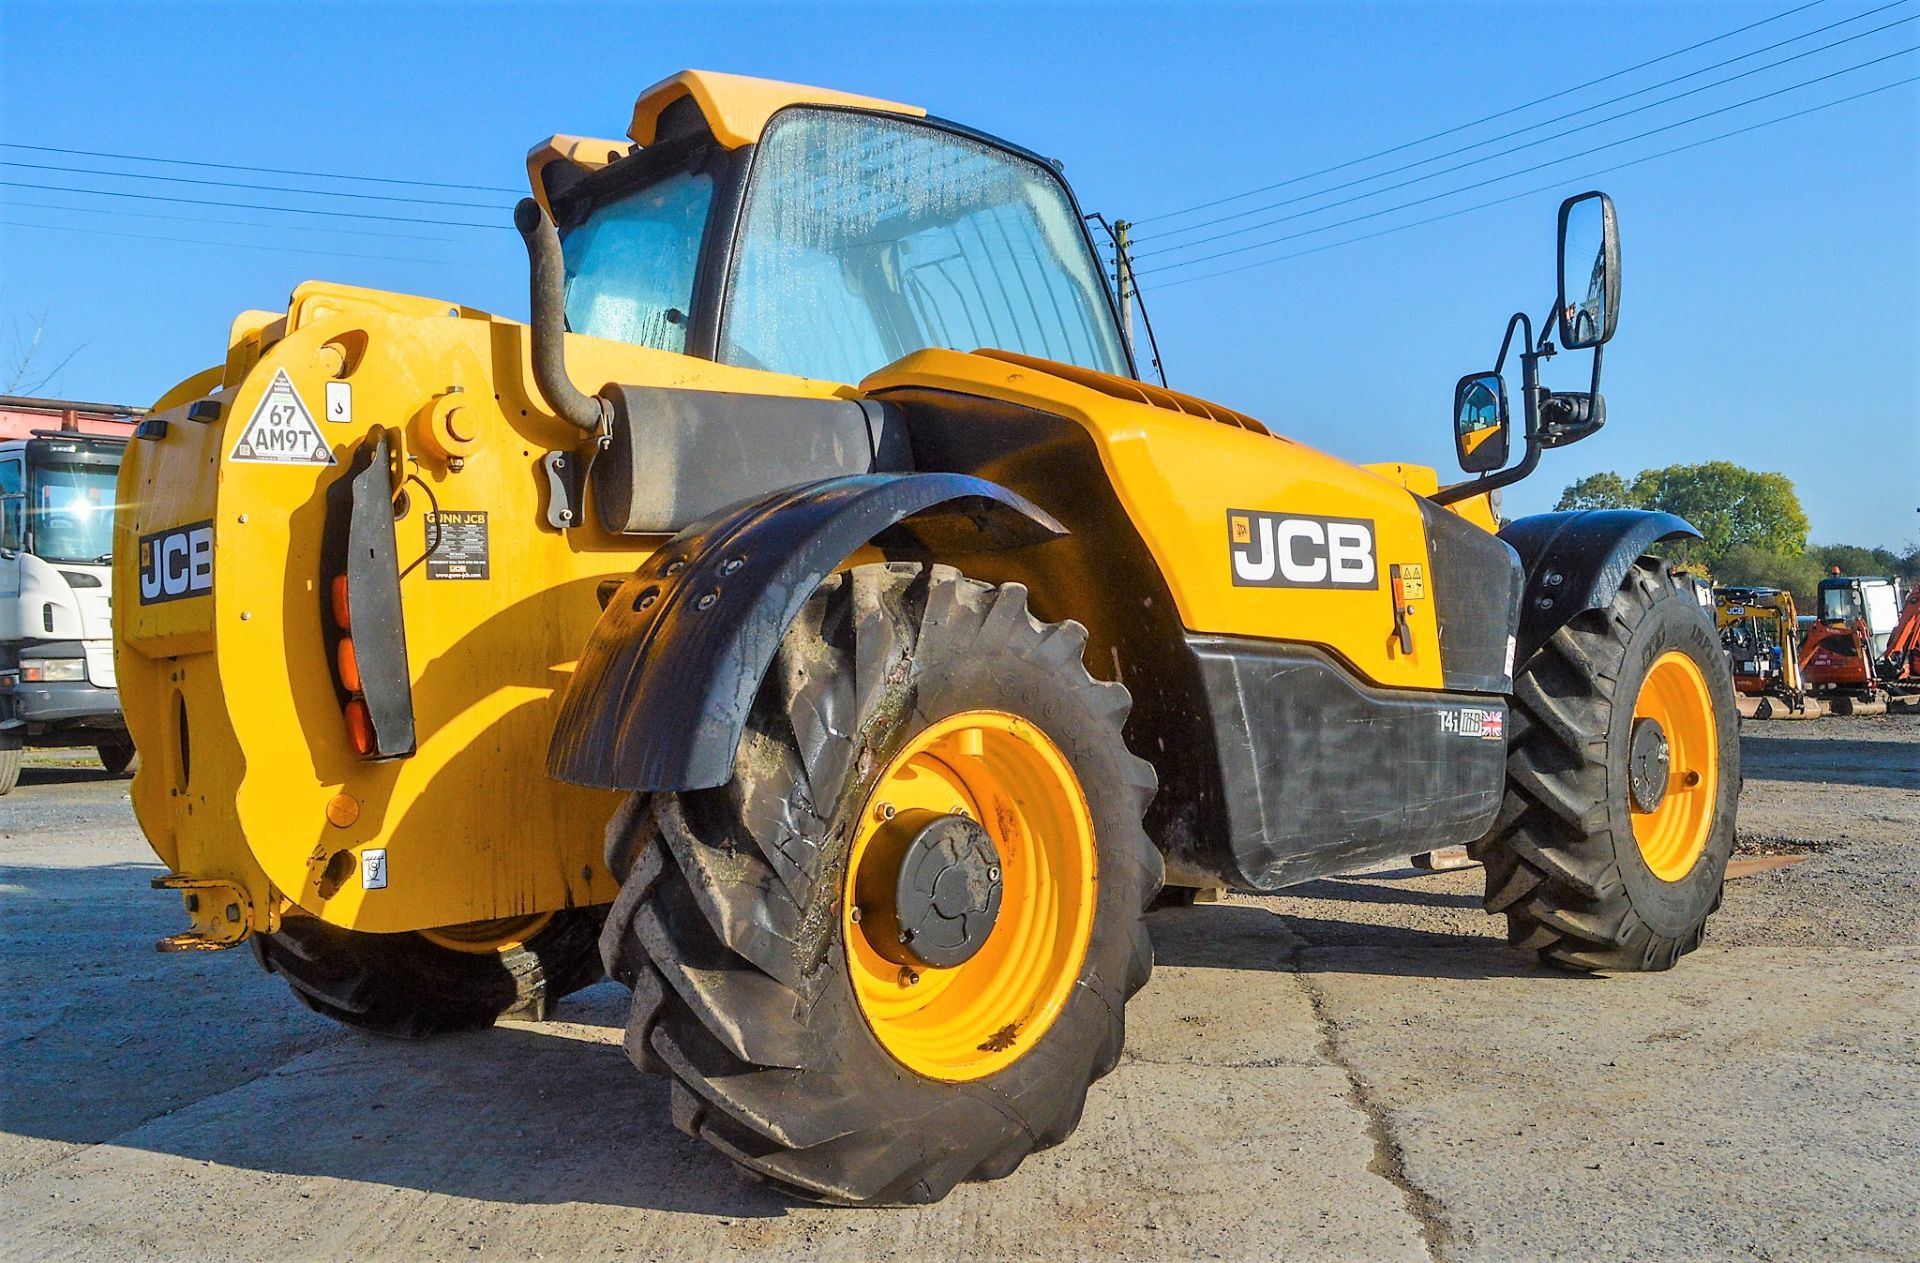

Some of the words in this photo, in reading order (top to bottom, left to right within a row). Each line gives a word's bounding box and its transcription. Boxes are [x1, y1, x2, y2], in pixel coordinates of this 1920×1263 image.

[270, 405, 296, 427] 67
[255, 428, 312, 452] AM9T
[464, 514, 486, 524] JCB
[1234, 517, 1375, 584] JCB
[141, 527, 214, 599] JCB
[1727, 607, 1745, 615] JCB
